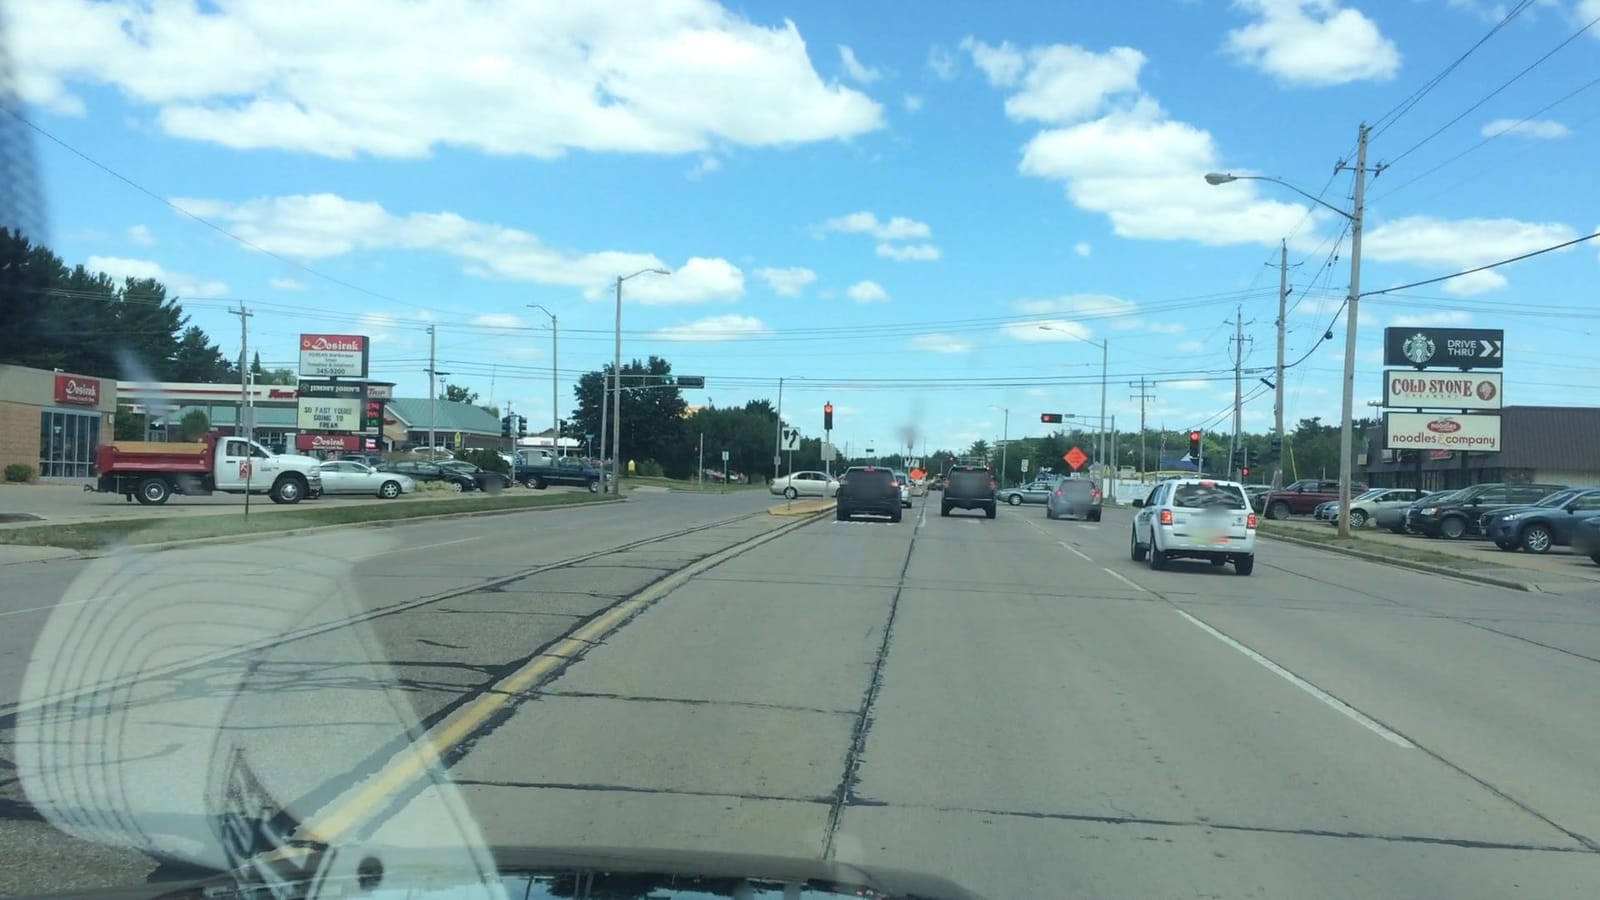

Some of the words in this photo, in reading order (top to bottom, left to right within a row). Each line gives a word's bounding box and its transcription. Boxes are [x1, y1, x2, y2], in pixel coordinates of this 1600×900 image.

[311, 337, 358, 351] Dosirak
[1447, 340, 1477, 348] DRIVE
[1447, 348, 1475, 357] THRU
[65, 379, 96, 396] Dosirak
[1392, 378, 1426, 396] COLD
[1429, 380, 1473, 397] STONE
[312, 435, 345, 446] Dosirak
[1392, 432, 1437, 443] noodles
[1445, 437, 1496, 448] company
